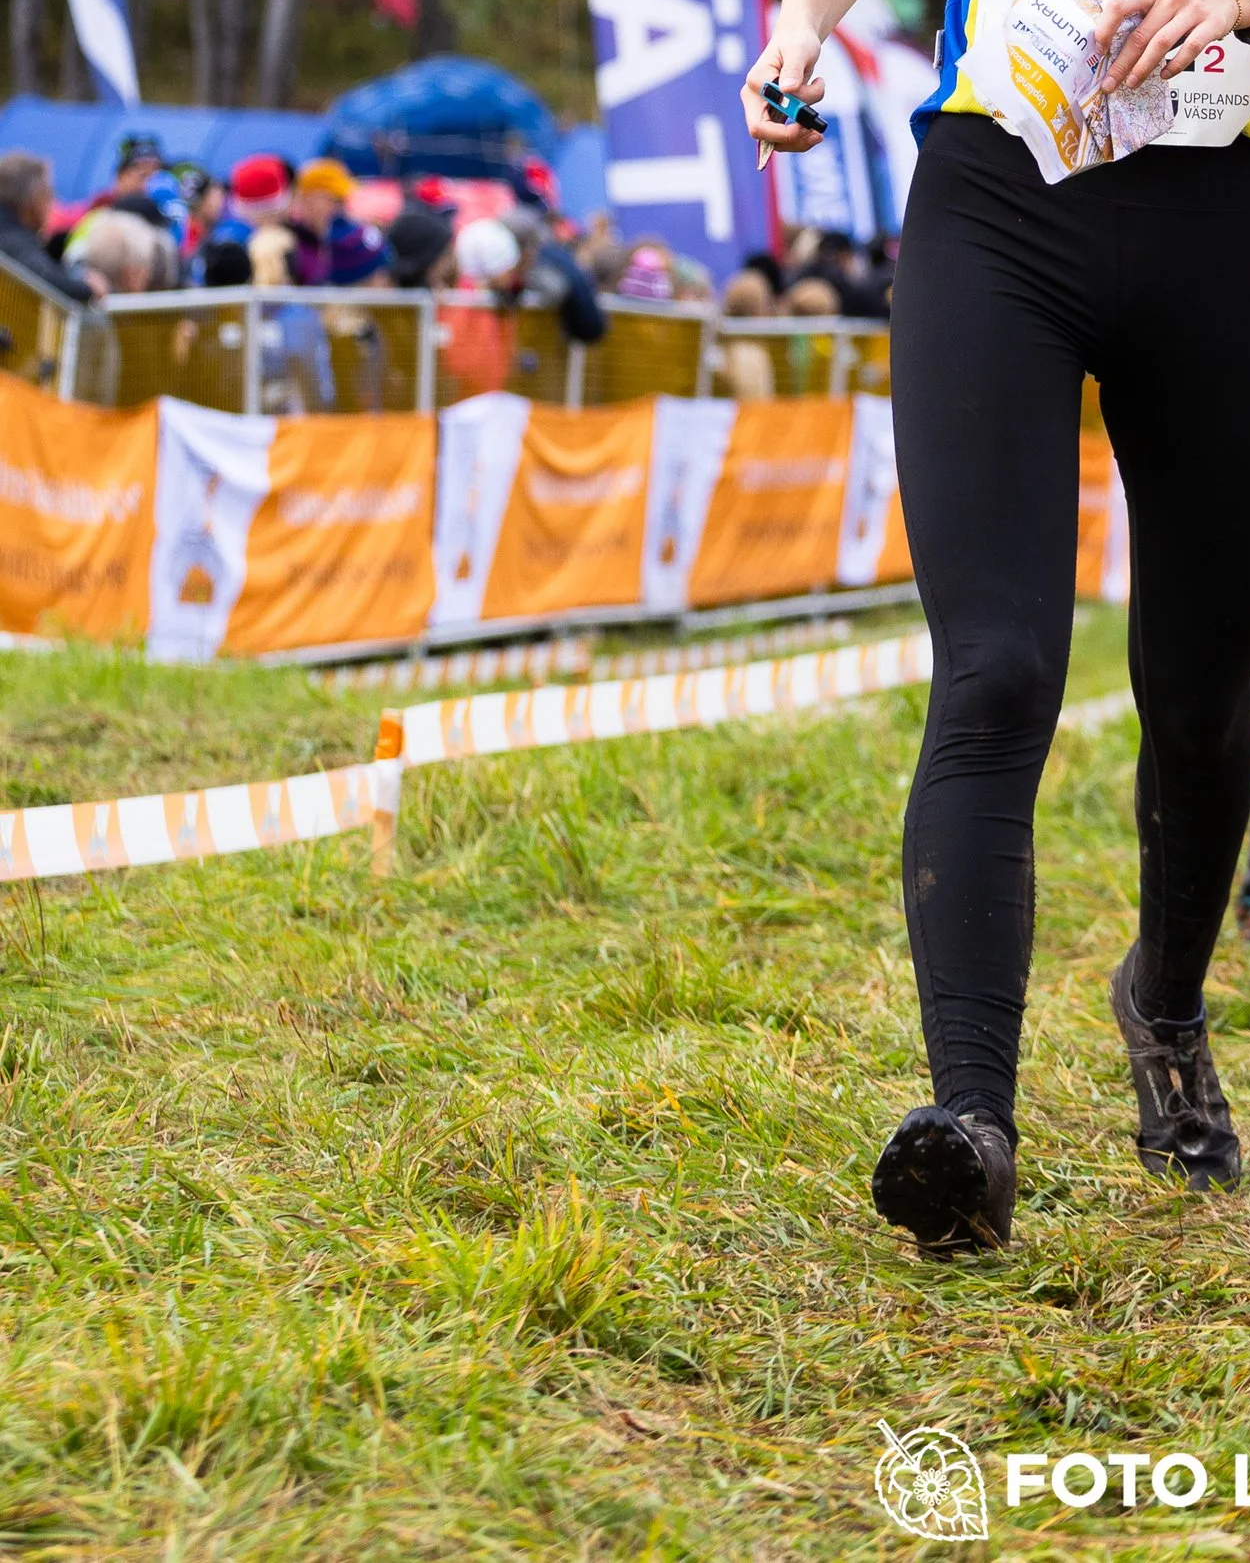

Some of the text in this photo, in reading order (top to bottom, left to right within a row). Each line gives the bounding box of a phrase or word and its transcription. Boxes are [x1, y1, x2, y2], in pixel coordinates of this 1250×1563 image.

[1009, 45, 1032, 71] oktob
[1203, 44, 1226, 74] 2
[1014, 70, 1048, 111] Upplands
[1183, 91, 1250, 107] UPPLANDS
[1183, 105, 1225, 121] VÄSBY
